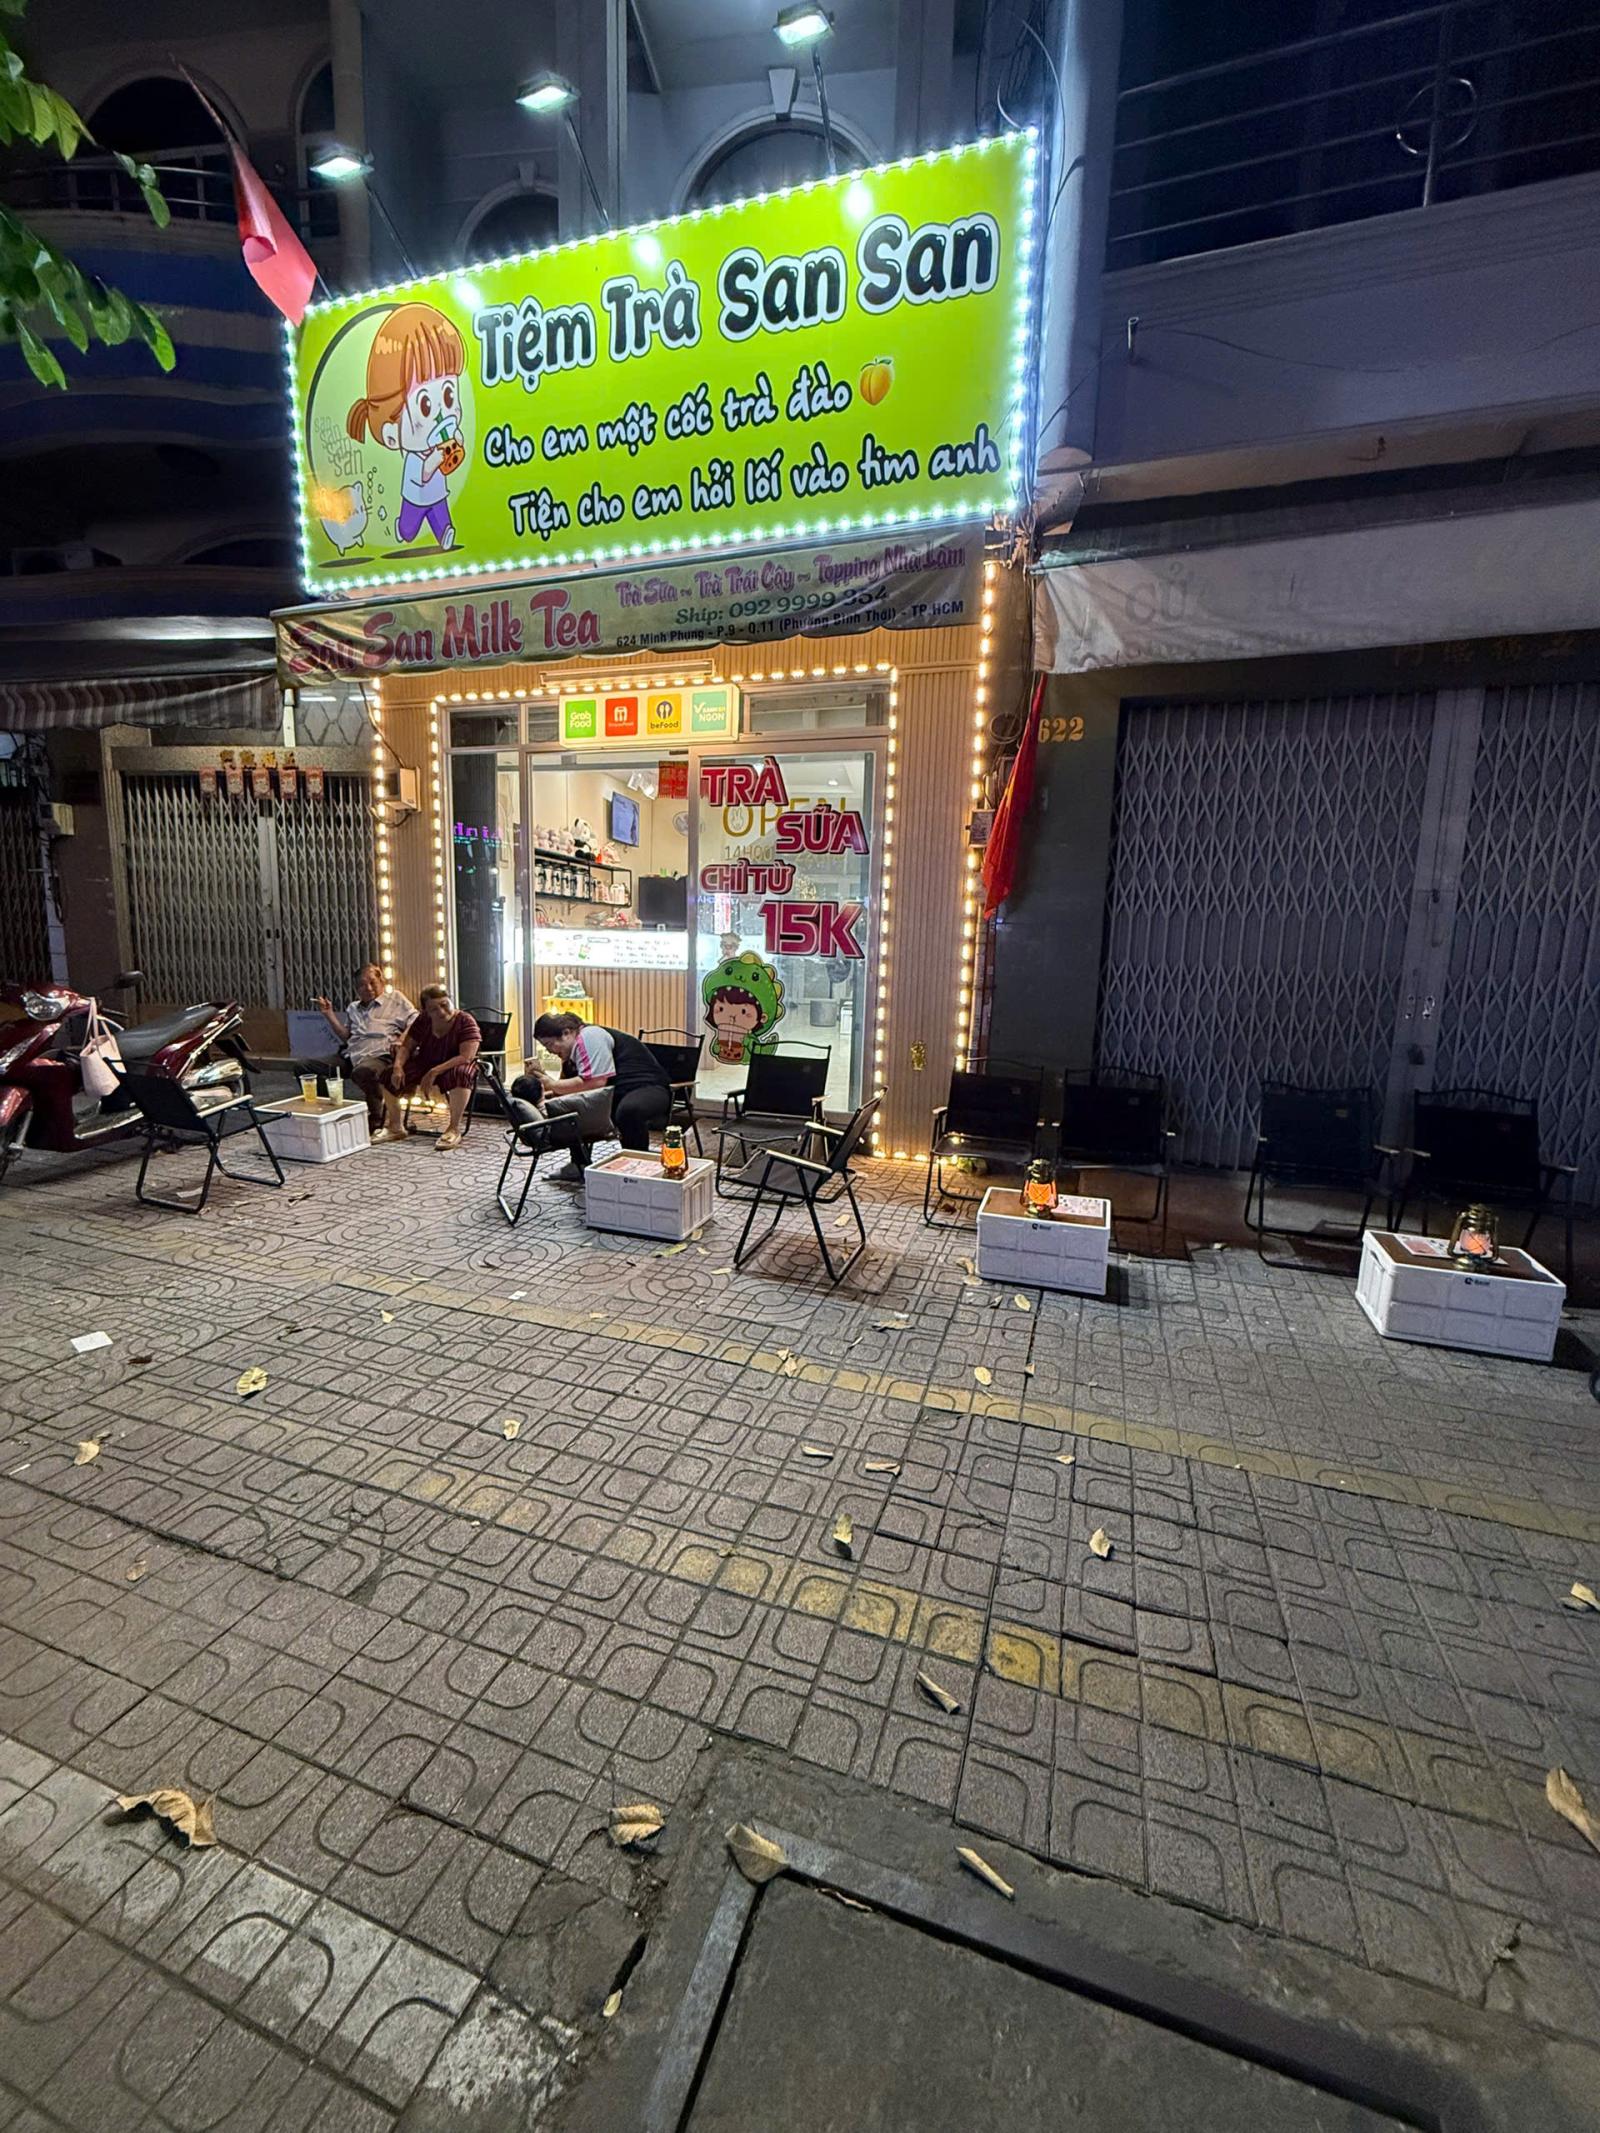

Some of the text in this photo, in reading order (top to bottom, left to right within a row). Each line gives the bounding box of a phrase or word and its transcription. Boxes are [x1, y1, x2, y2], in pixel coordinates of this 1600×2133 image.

[474, 212, 1000, 393] Tiệm Trà San San
[484, 361, 852, 467] Cho em một cốc trà đào
[334, 449, 364, 477] san
[509, 423, 1000, 540] Tiện cho em hỏi lối vào tim anh
[615, 581, 643, 608] Trà
[695, 570, 723, 599] Trà
[725, 566, 758, 594] Trái
[761, 560, 795, 593] Cây
[813, 553, 880, 588] Topping
[362, 611, 435, 668] San
[441, 600, 524, 660] Milk
[530, 589, 601, 649] Tea
[675, 606, 724, 625] Ship:
[729, 598, 771, 618] 092
[777, 591, 836, 613] 9999
[616, 636, 636, 649] 624
[640, 632, 667, 646] Minh
[717, 625, 735, 638] P.9
[570, 711, 592, 721] Grab
[570, 719, 592, 728] Food
[650, 720, 679, 730] beFood
[1038, 716, 1085, 743] 622
[700, 755, 789, 807] TRÀ
[775, 804, 869, 855] SỮA
[699, 858, 796, 895] CHỈ TỪ
[757, 900, 865, 958] 15K
